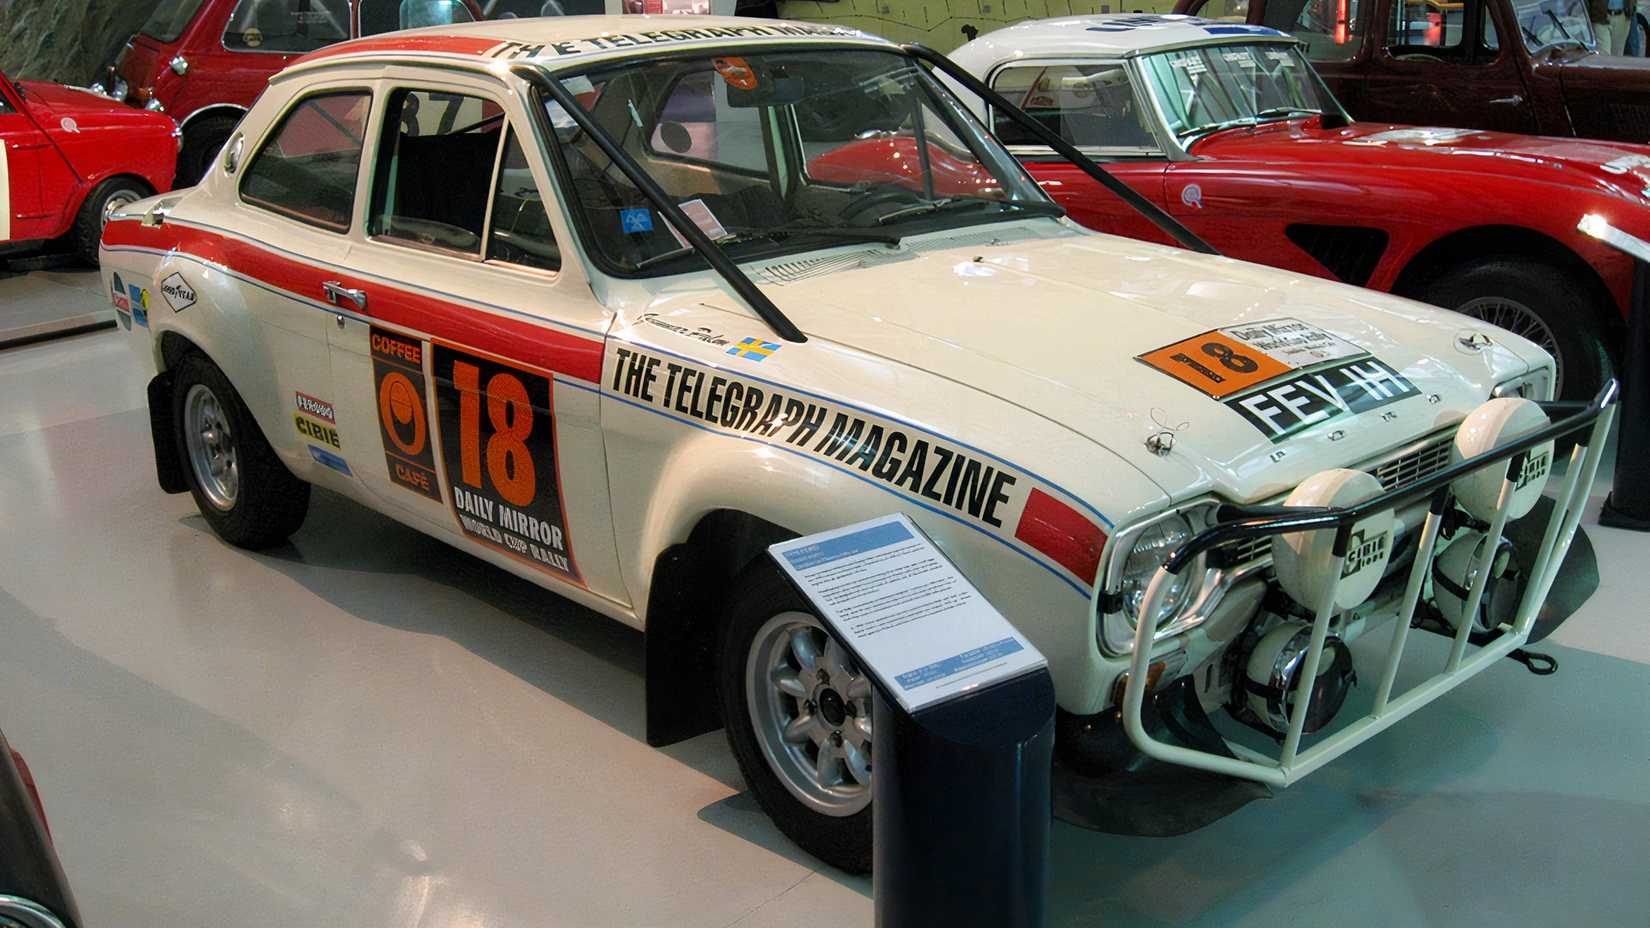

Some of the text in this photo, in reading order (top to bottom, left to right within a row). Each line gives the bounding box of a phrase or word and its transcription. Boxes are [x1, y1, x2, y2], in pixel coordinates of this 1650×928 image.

[491, 40, 581, 59] THE
[372, 334, 421, 364] COFFEE
[295, 416, 341, 449] CIBIE
[453, 360, 536, 508] 18
[1239, 374, 1350, 436] FEV
[613, 348, 1017, 528] THE TELEGRAPH MAGAZINE
[454, 486, 563, 551] DAILY MIRROR
[460, 514, 569, 572] WORLD CUP RALLY
